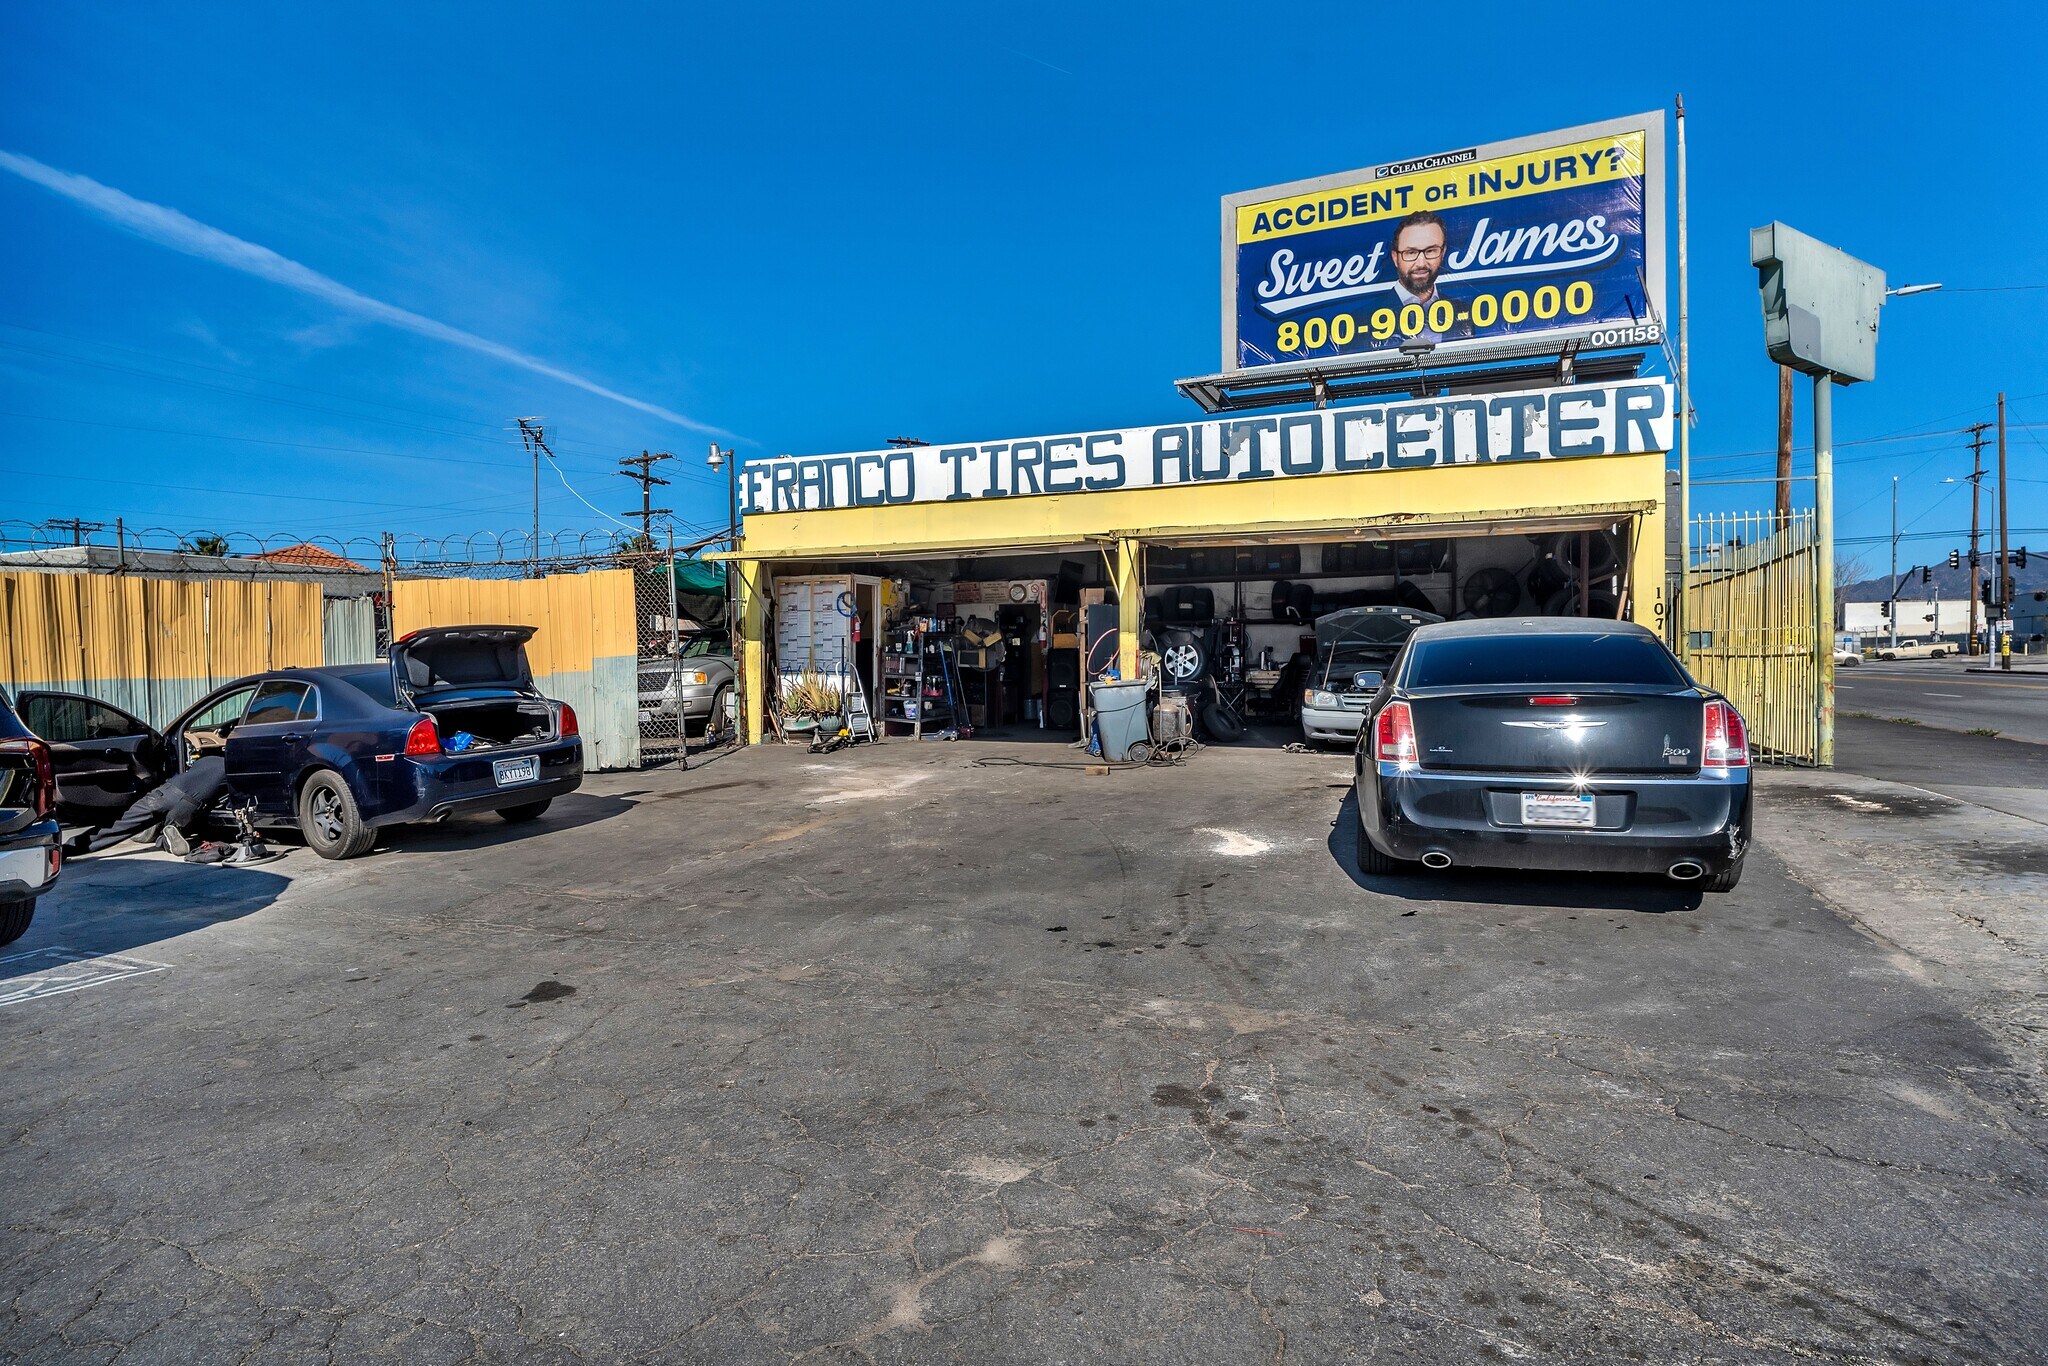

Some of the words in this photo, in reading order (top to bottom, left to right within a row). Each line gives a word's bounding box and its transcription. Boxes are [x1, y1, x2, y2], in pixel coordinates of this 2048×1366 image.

[1252, 185, 1413, 235] ACCIDENT
[1425, 182, 1458, 202] OR
[1468, 147, 1625, 197] INJURY?
[1257, 241, 1385, 298] Sweet
[1447, 215, 1619, 272] James
[1277, 281, 1594, 352] 800-900-0000
[1591, 325, 1660, 346] 001158
[741, 452, 915, 515] FRANCO
[940, 433, 1126, 500] TIRES
[1654, 586, 1664, 639] 107
[499, 767, 531, 780] 8KYT198
[1664, 747, 1690, 756] 300
